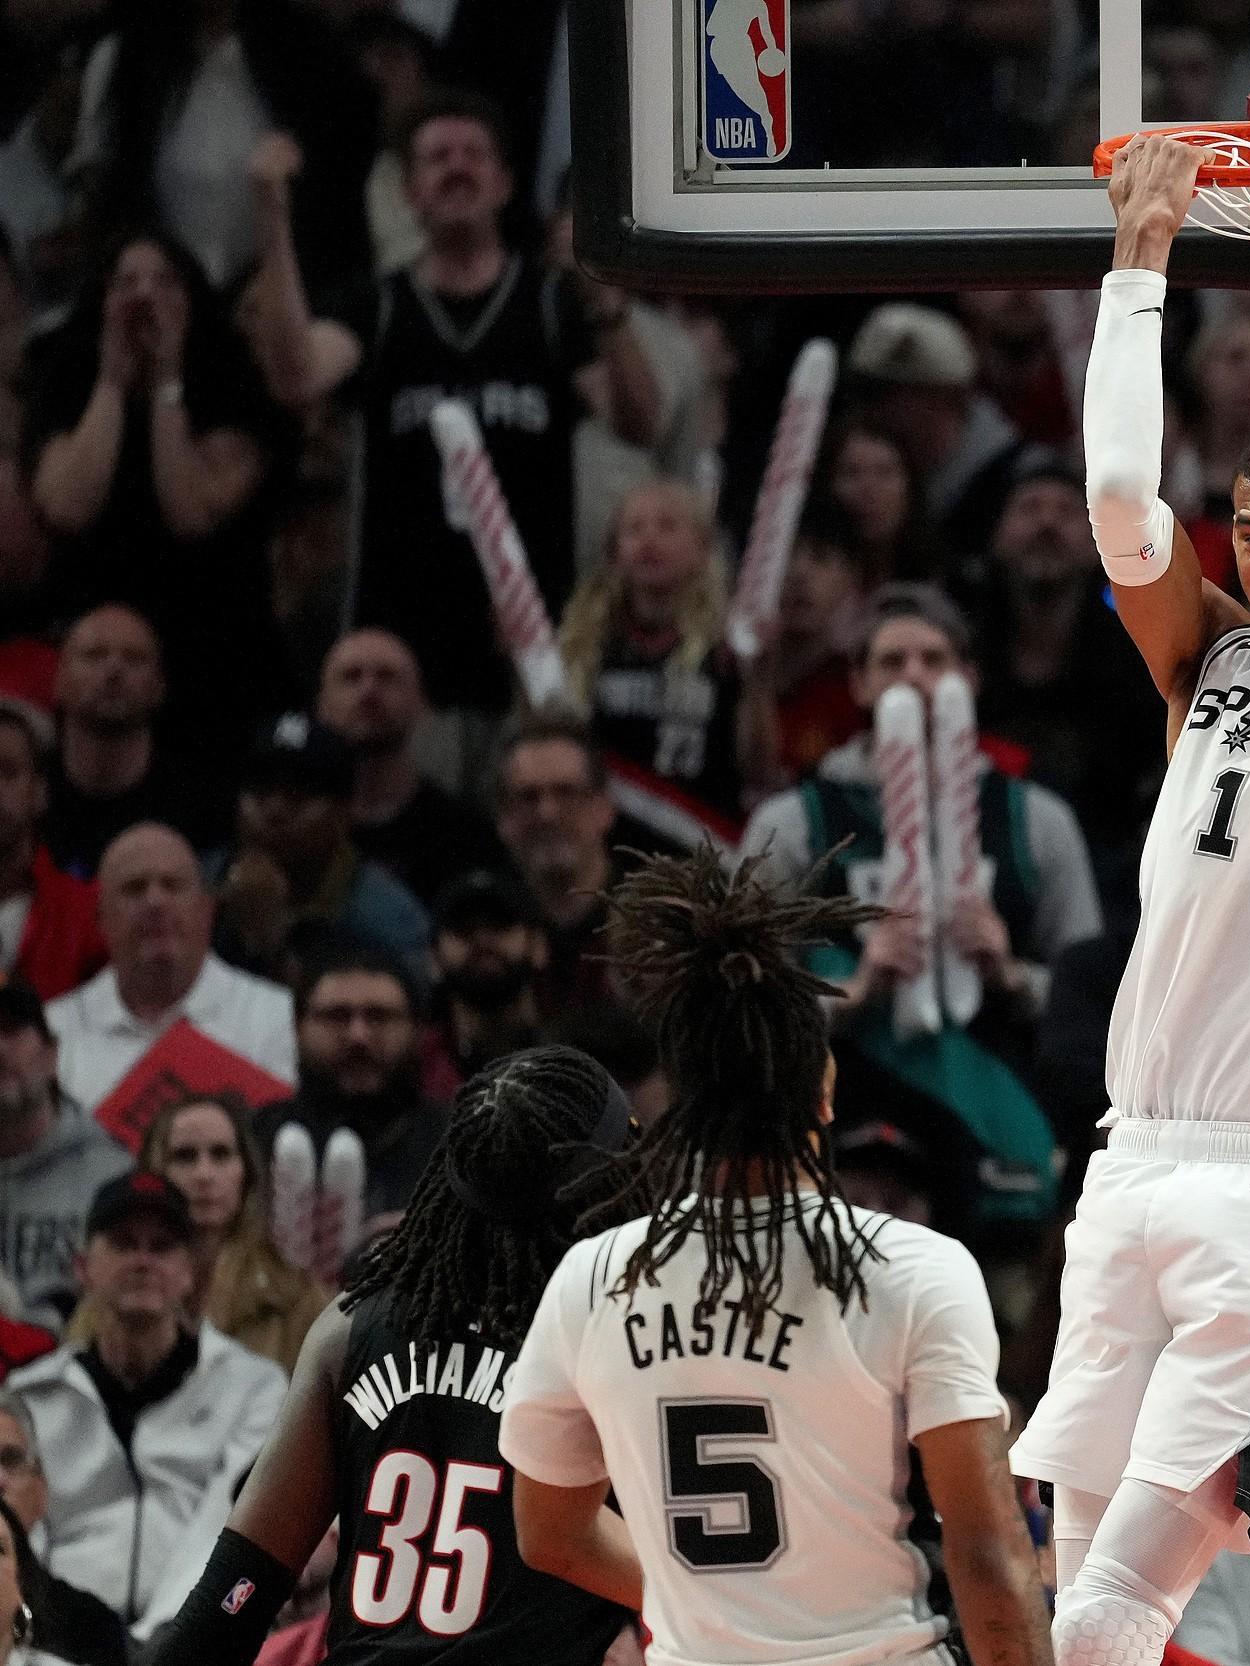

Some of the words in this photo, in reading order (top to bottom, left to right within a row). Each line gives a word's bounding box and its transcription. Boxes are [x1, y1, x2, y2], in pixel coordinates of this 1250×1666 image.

[715, 117, 757, 149] NBA
[1193, 767, 1250, 862] 1
[625, 1299, 803, 1371] CASTLE
[343, 1340, 516, 1431] WILLIAMS
[657, 1396, 789, 1575] 5
[350, 1448, 503, 1639] 35
